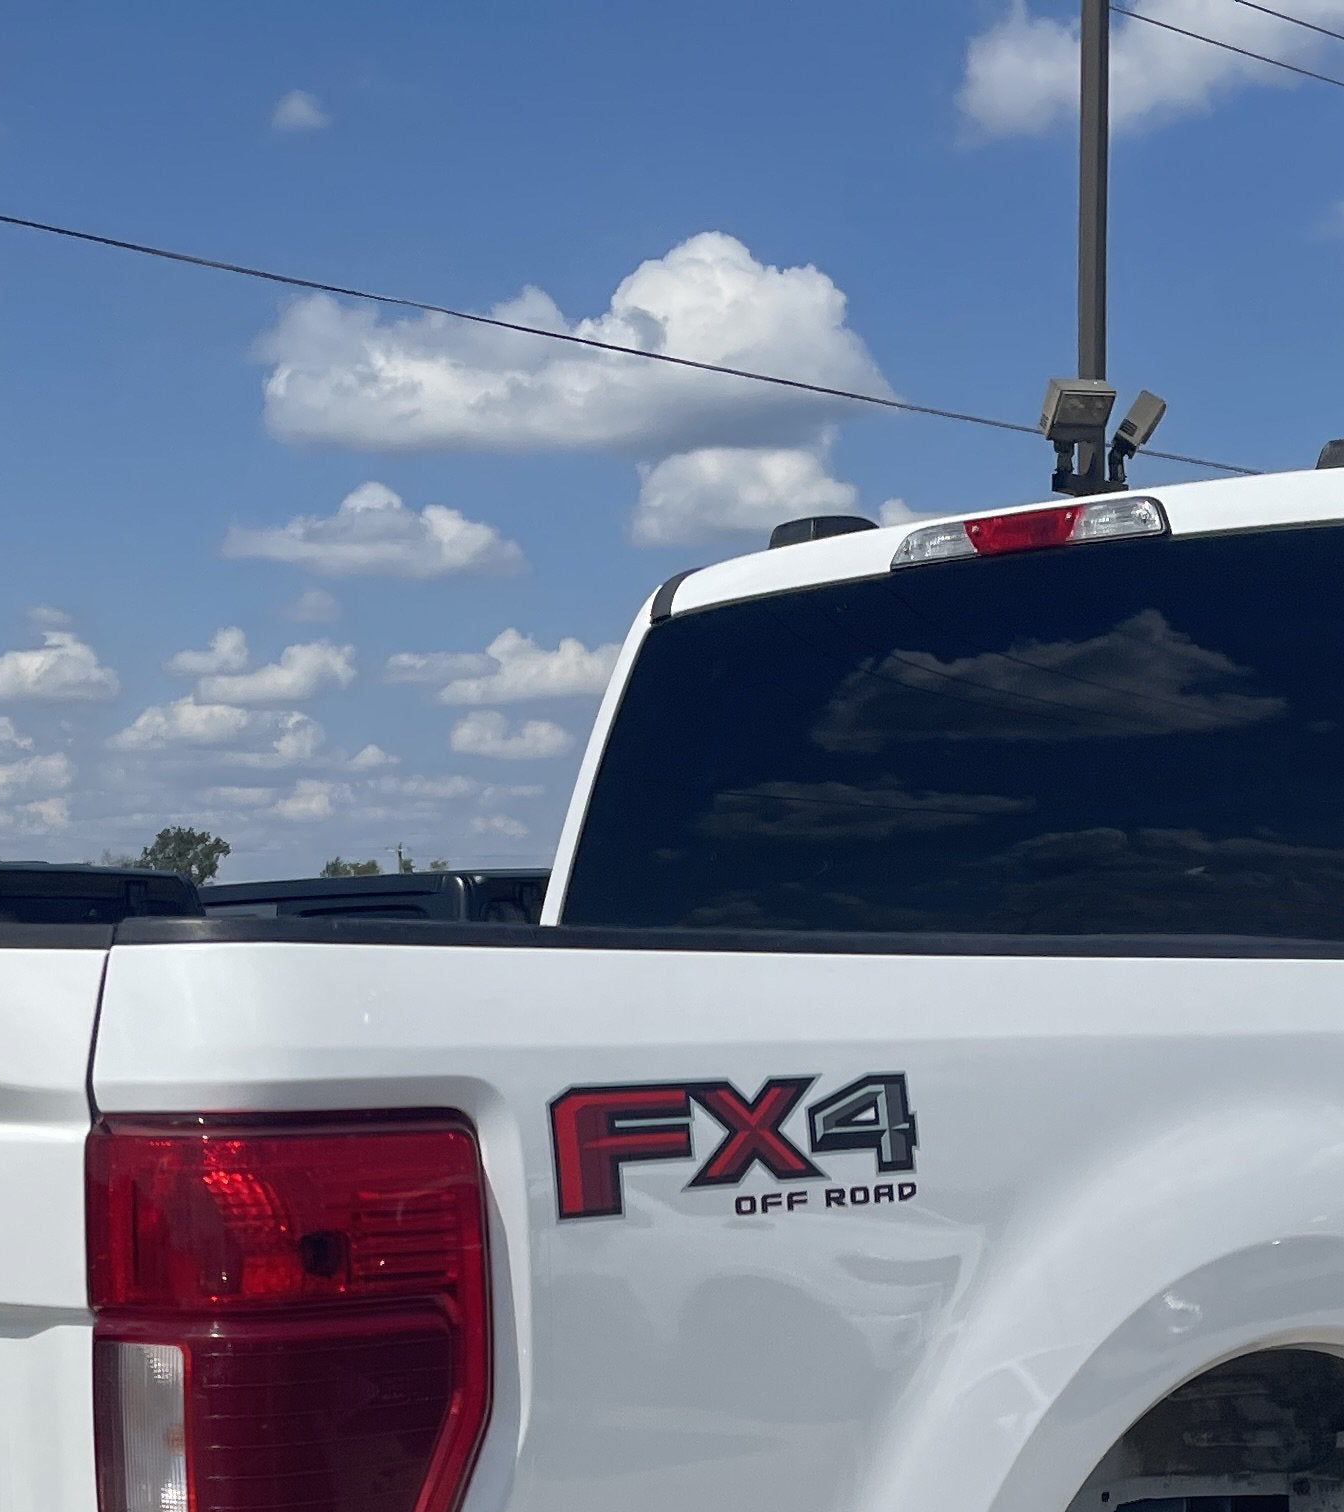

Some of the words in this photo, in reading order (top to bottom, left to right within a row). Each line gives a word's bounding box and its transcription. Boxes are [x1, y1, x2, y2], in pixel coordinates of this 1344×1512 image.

[546, 1072, 920, 1222] FX4
[735, 1190, 808, 1216] OFF
[825, 1182, 918, 1209] ROAD
